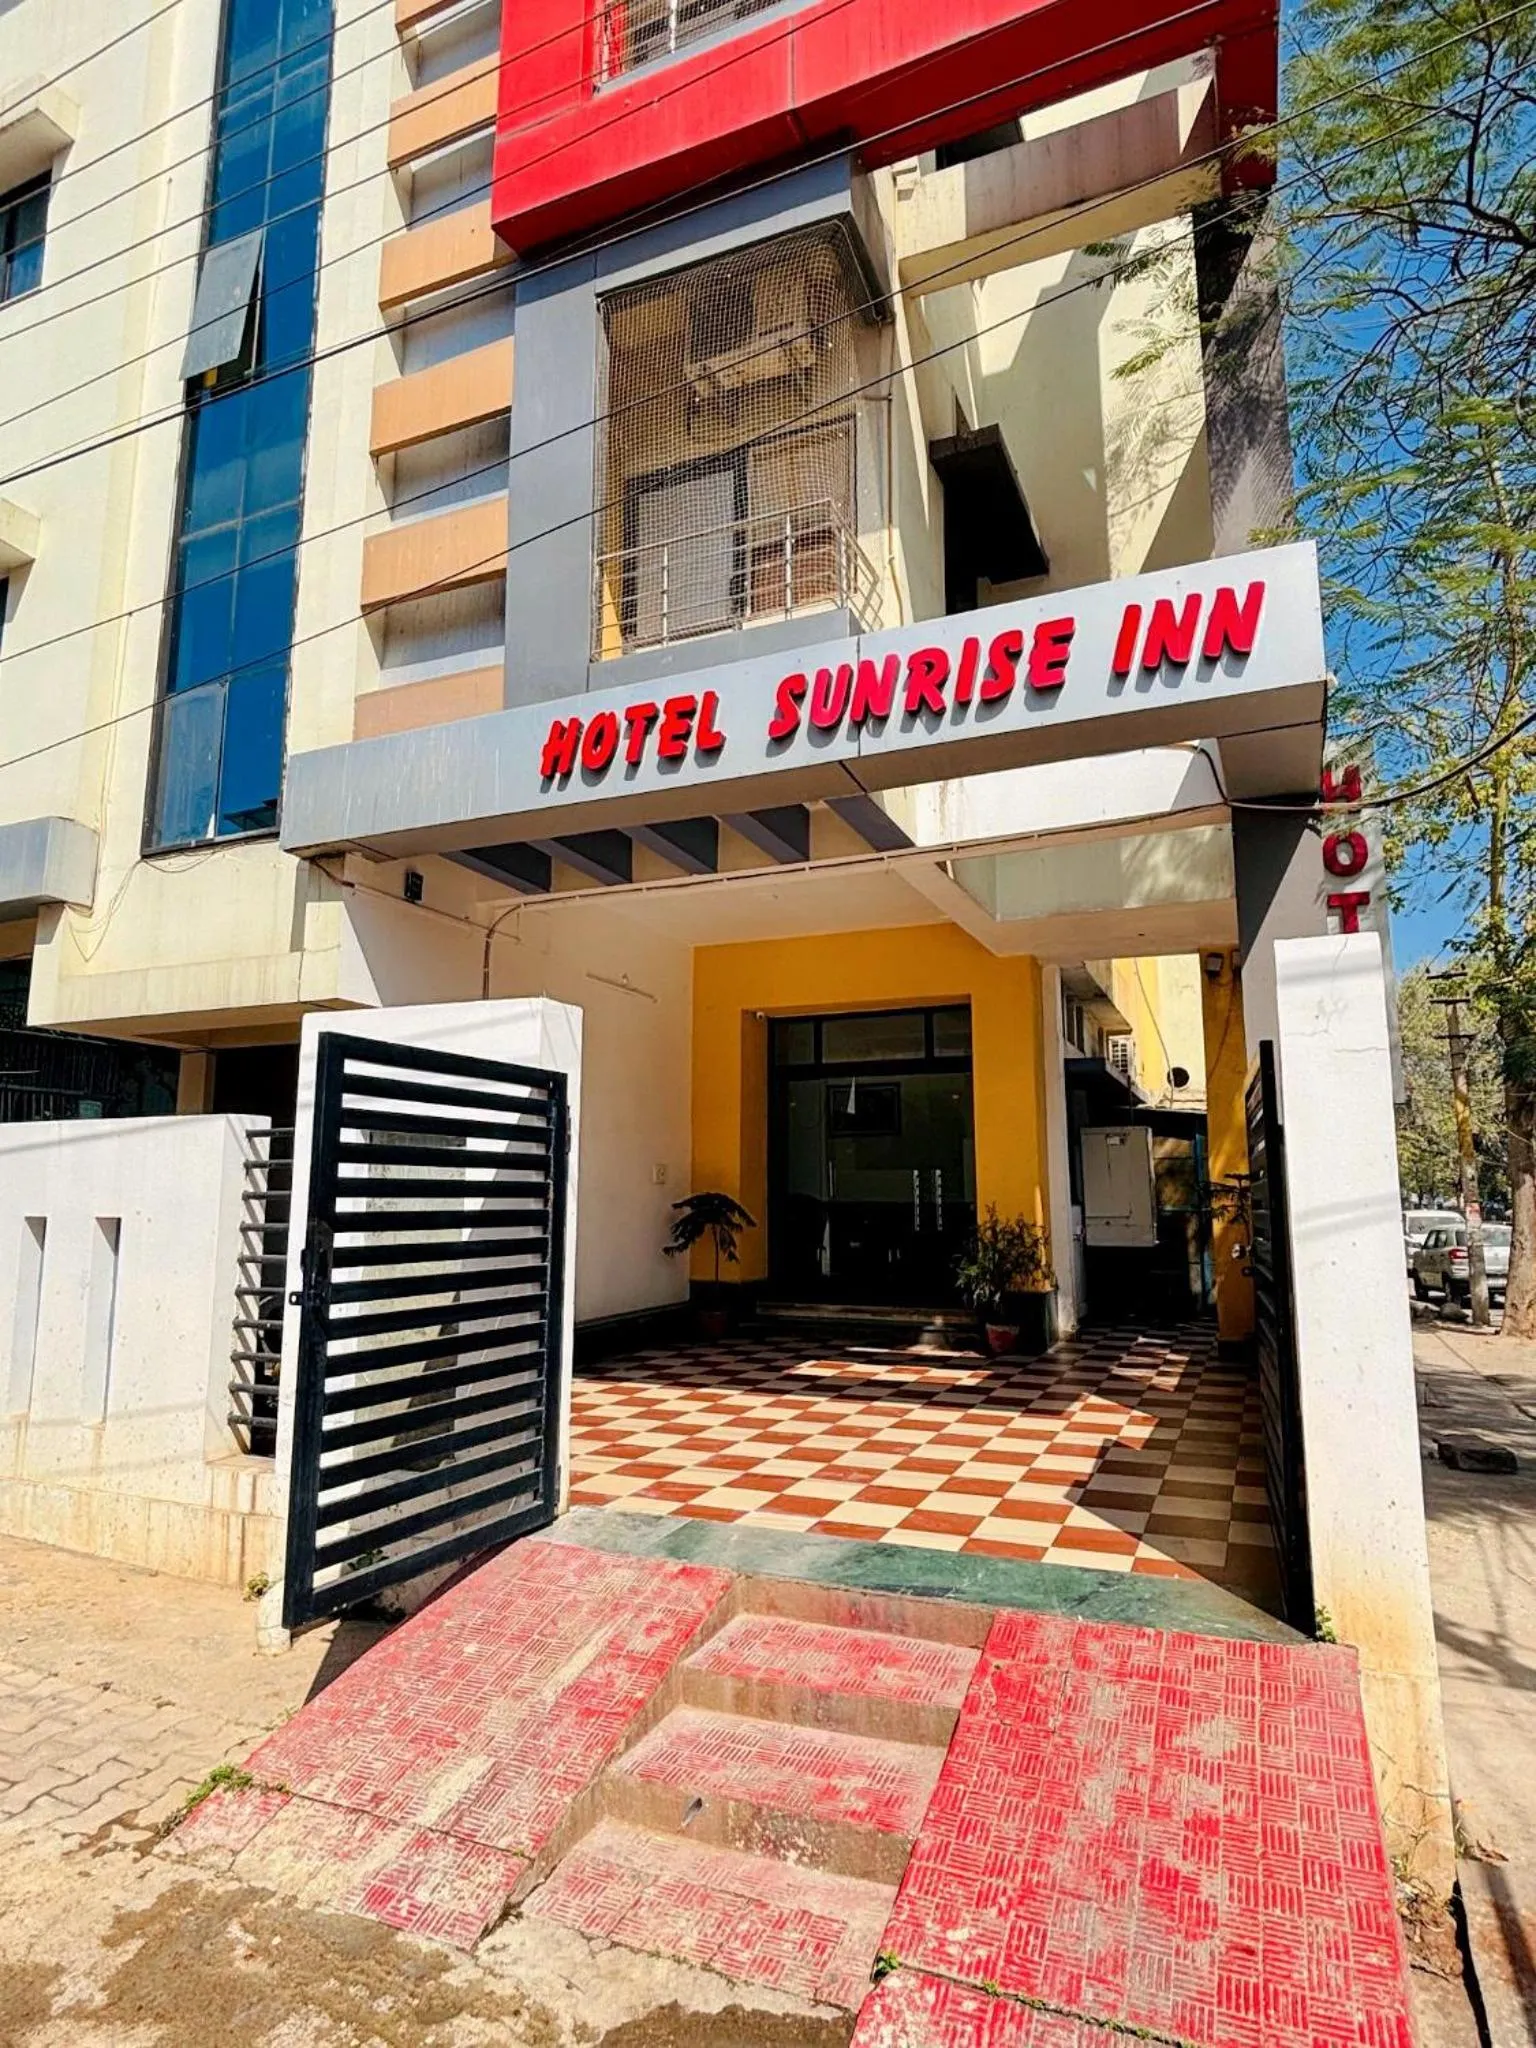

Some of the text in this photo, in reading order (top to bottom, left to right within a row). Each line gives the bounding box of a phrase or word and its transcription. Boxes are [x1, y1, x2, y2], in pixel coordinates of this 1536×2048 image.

[540, 581, 1266, 780] HOTEL SUNRISE INN
